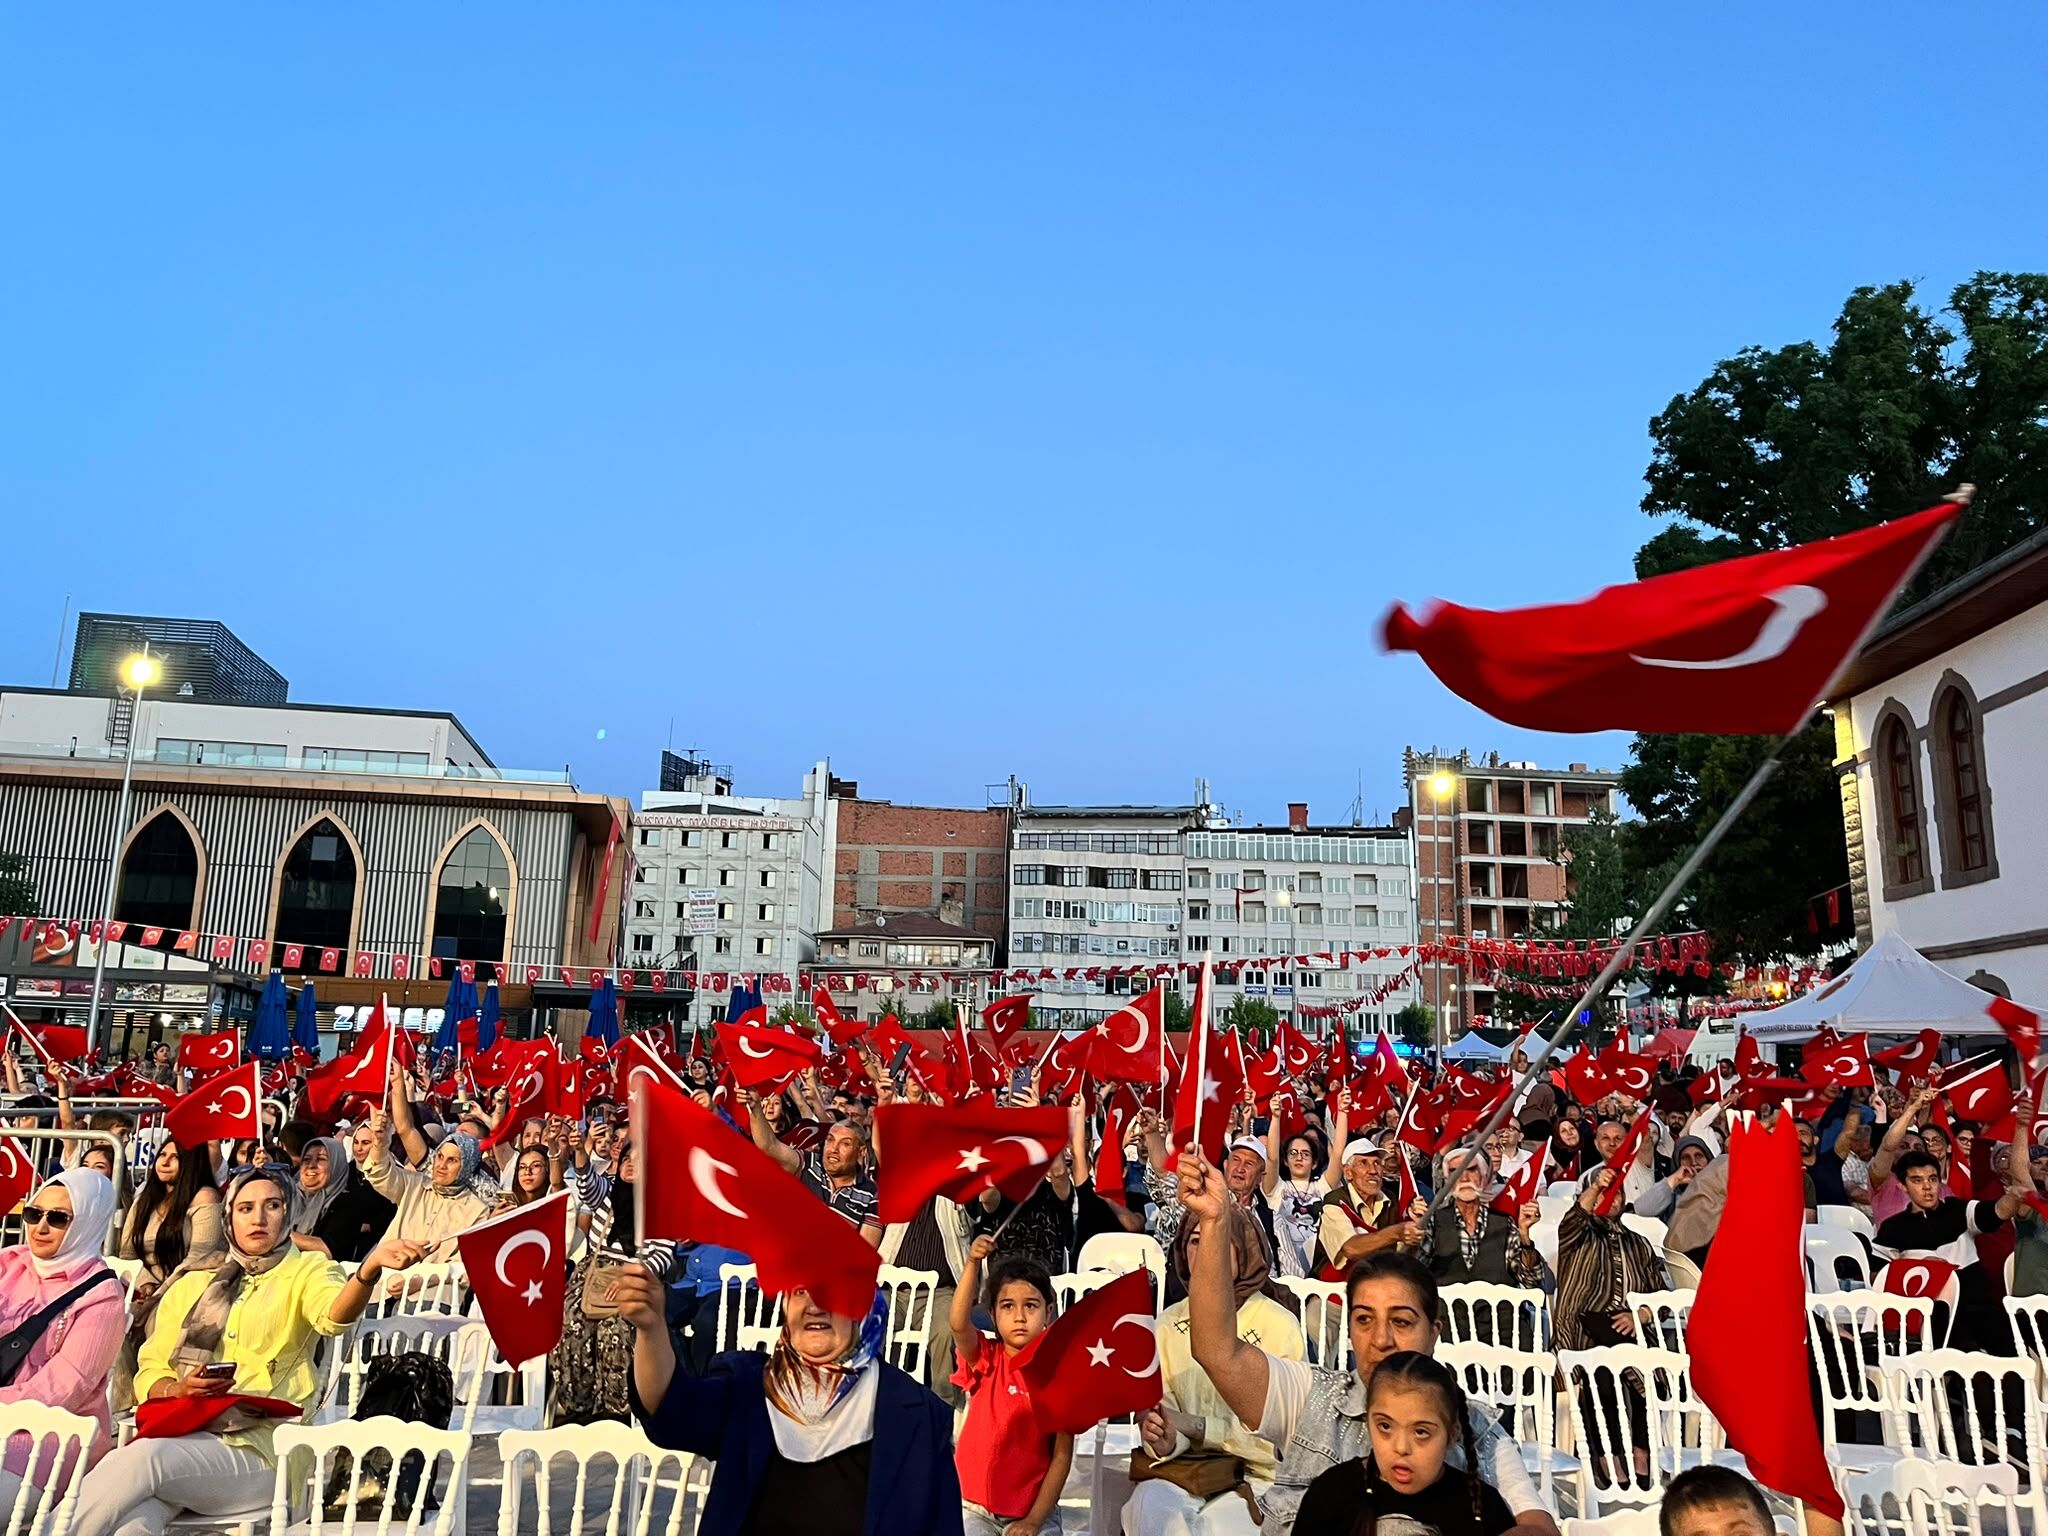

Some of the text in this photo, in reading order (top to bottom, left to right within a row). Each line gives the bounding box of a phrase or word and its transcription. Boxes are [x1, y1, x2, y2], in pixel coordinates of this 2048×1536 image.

[632, 815, 794, 829] AKMAK MARBLE HOTEL
